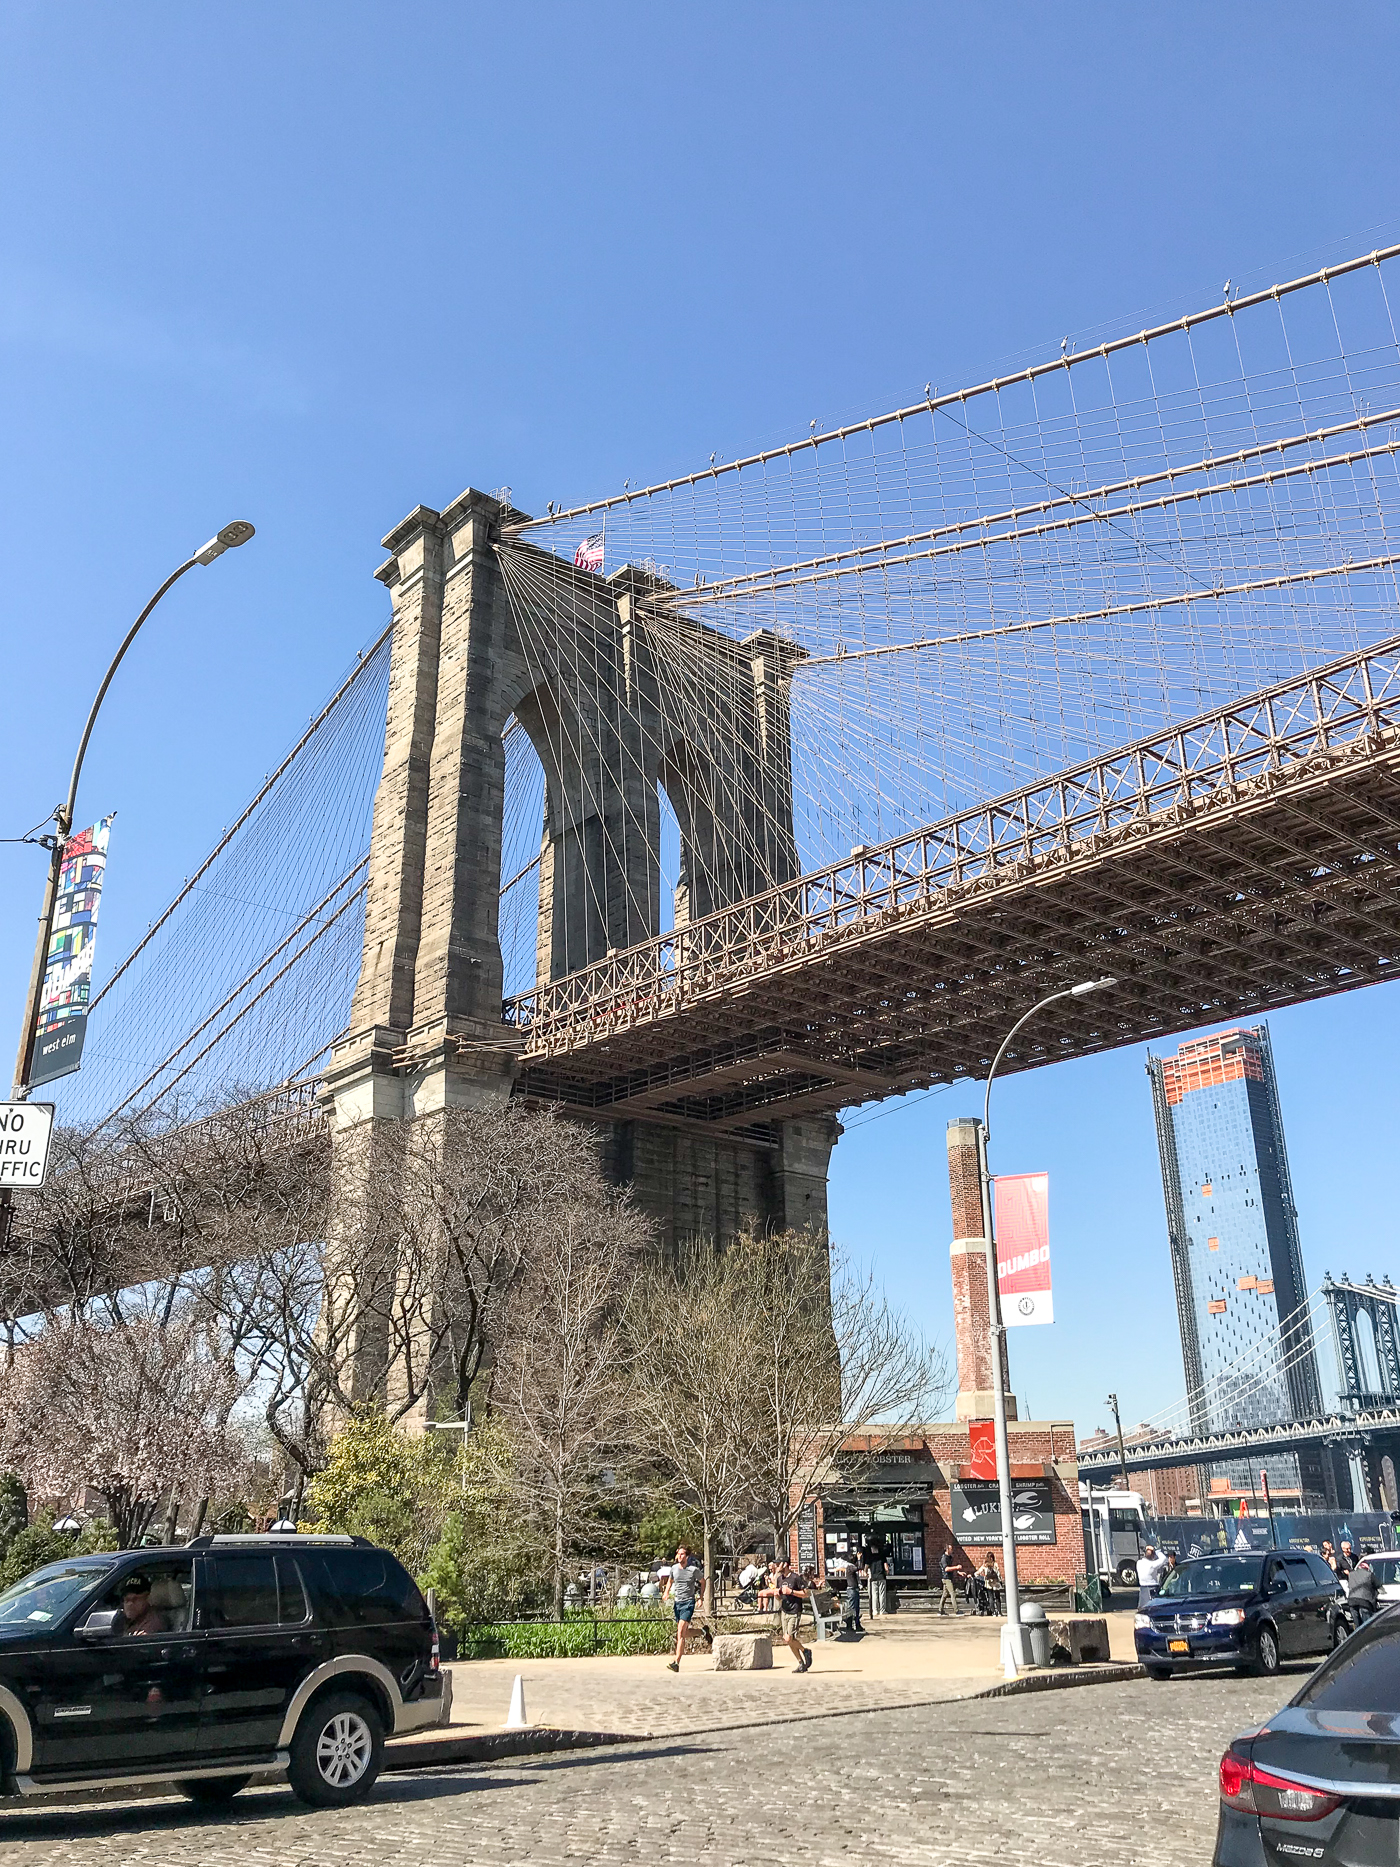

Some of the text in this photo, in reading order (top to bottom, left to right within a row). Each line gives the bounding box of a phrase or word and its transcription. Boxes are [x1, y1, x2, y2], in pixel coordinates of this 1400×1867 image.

[42, 1033, 76, 1055] west elm
[0, 1114, 24, 1132] NO
[0, 1139, 31, 1155] RU
[0, 1161, 41, 1177] FFIC
[997, 1244, 1051, 1279] DUMBO
